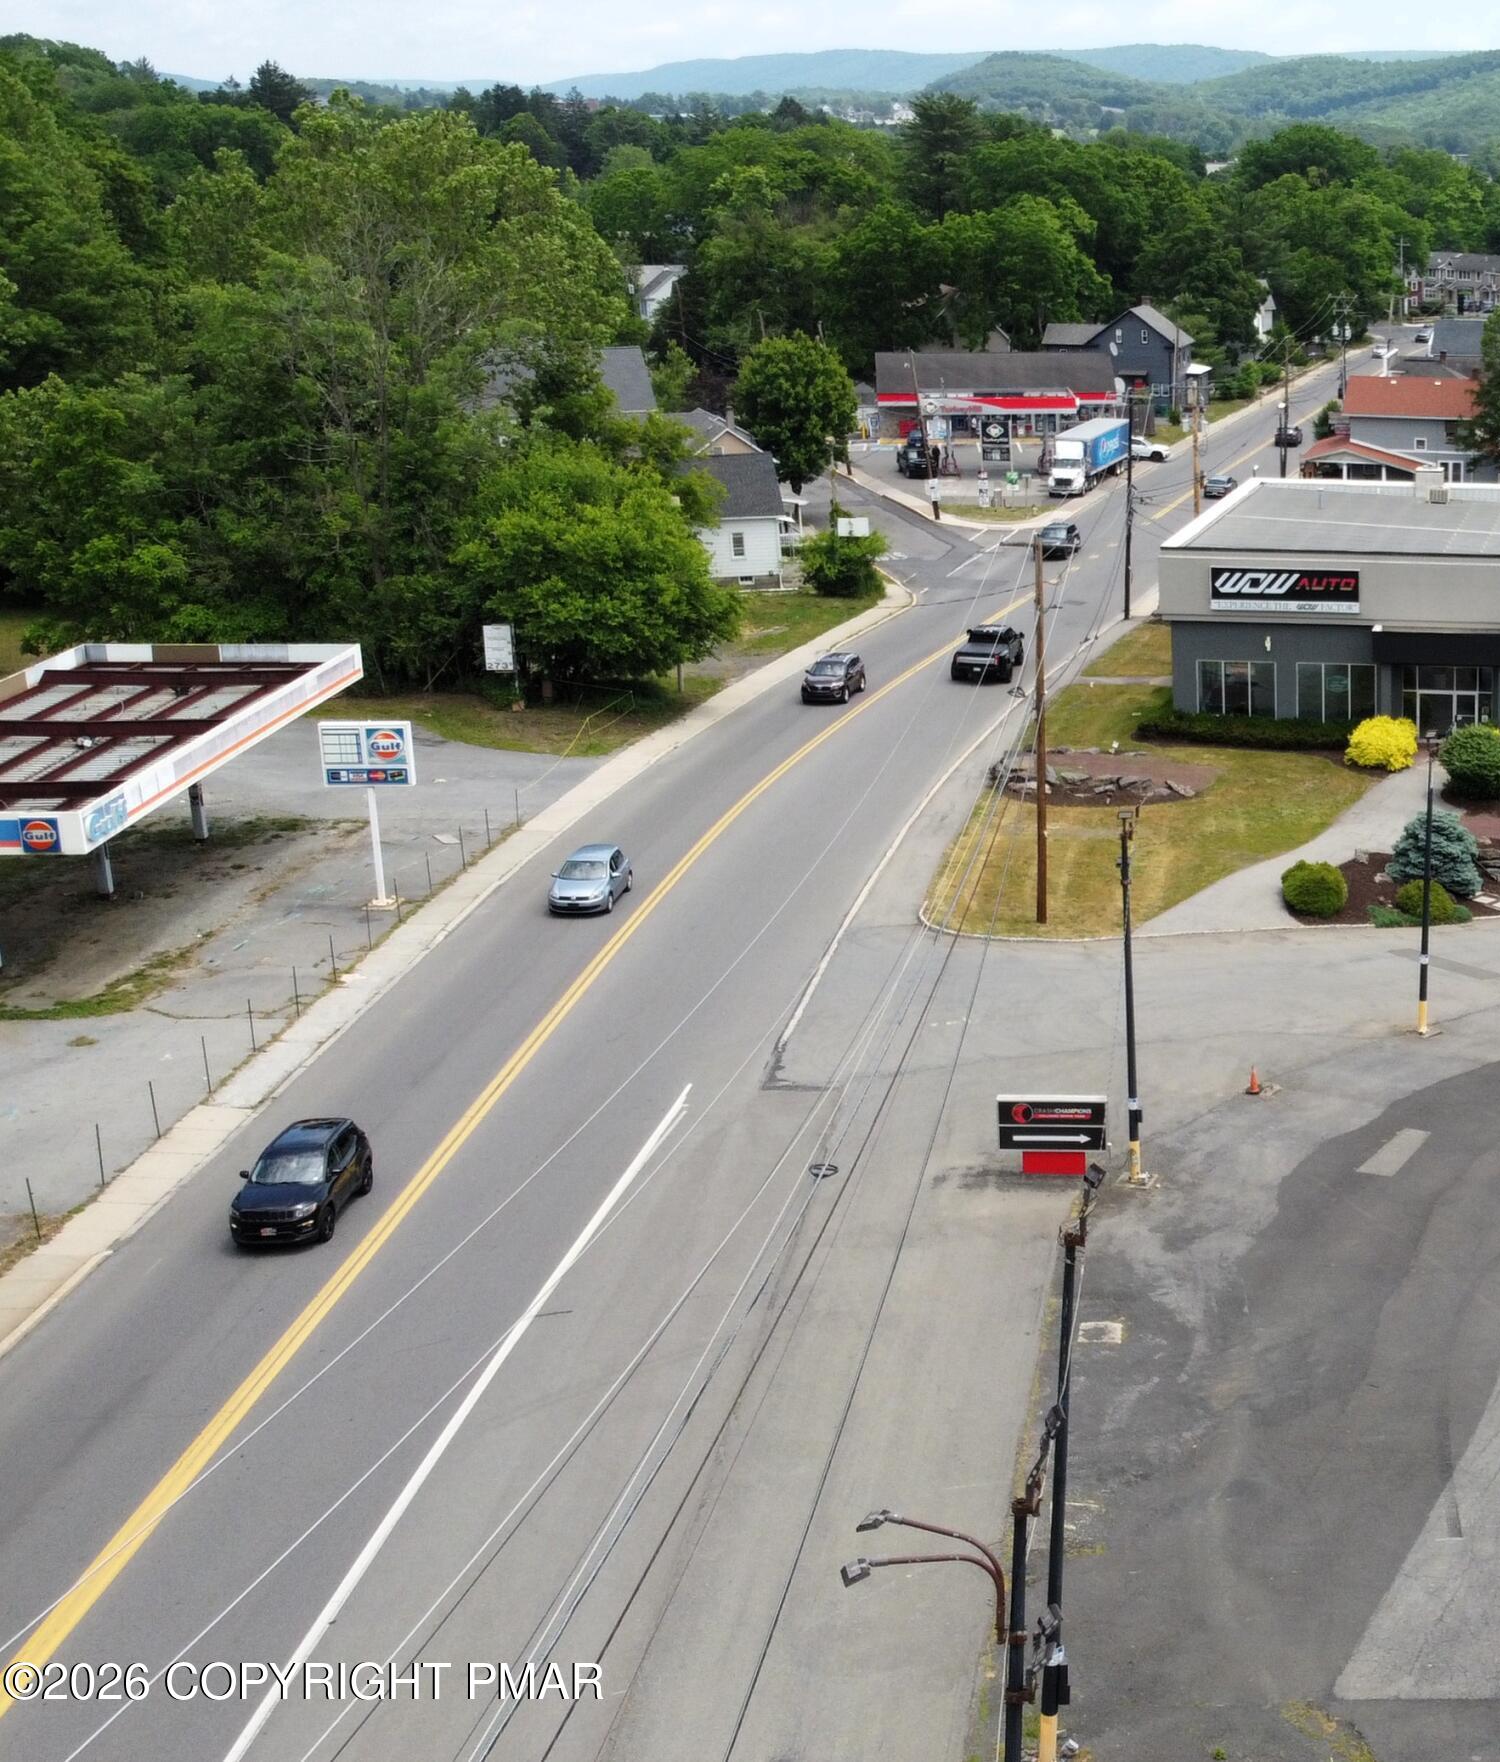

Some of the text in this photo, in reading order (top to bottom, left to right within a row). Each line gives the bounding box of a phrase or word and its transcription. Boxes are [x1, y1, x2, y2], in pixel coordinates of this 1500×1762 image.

[1214, 572, 1357, 594] WOW AUTO
[370, 741, 401, 751] Gulf
[24, 831, 56, 841] Gulf
